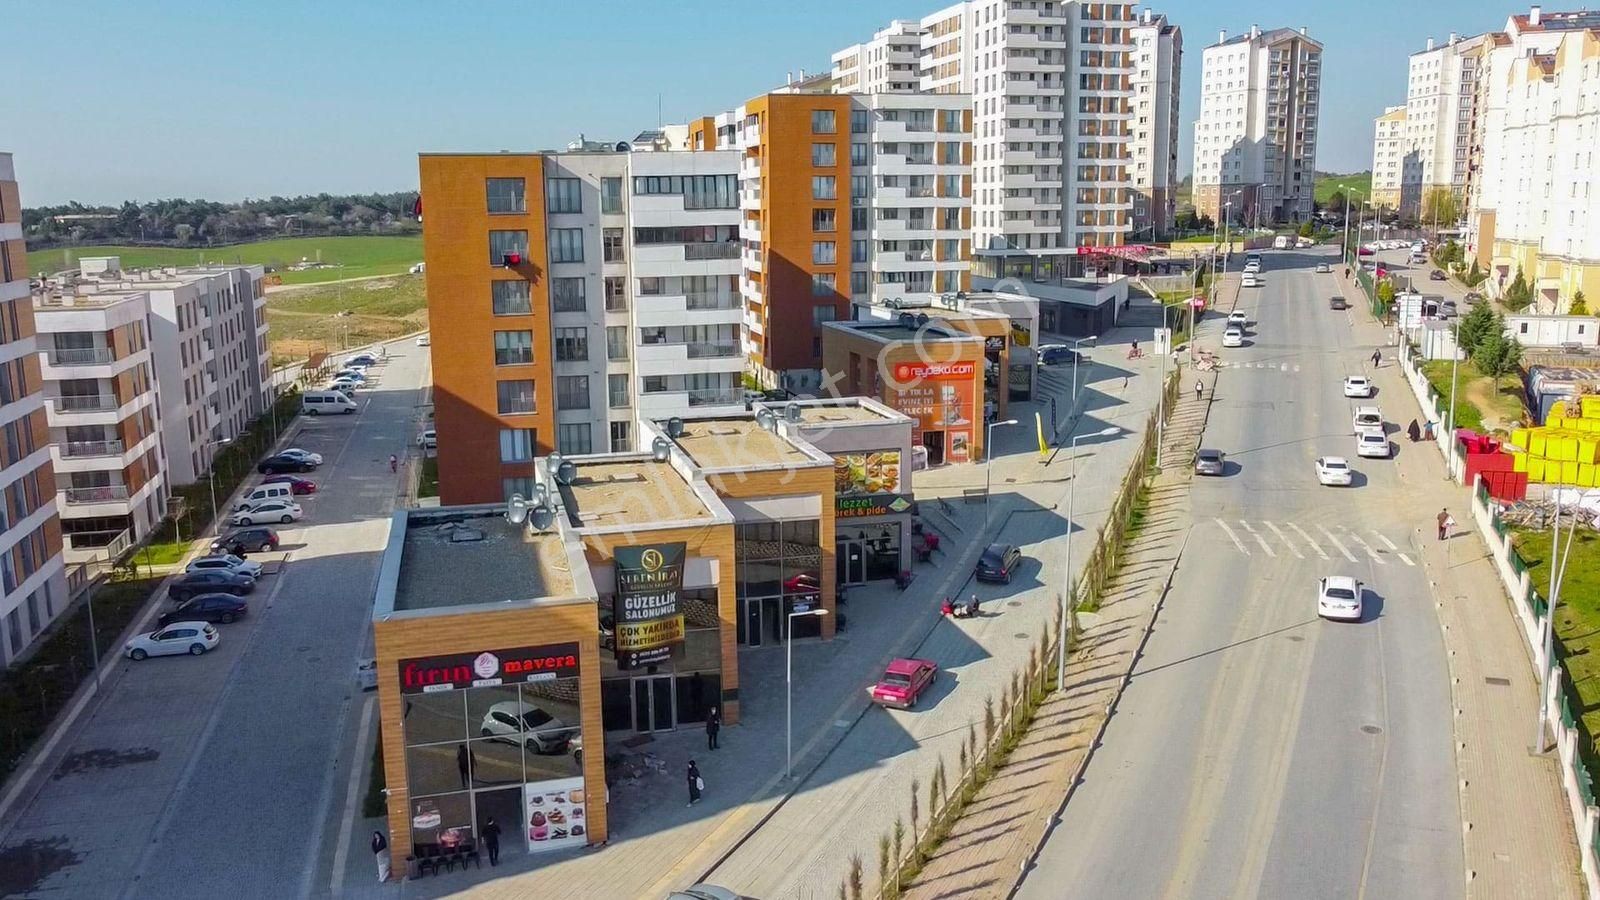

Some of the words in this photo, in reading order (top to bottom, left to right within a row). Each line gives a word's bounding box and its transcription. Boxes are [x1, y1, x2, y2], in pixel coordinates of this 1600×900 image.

[910, 363, 974, 378] reydeko.com
[839, 497, 874, 509] lezzet
[857, 507, 865, 516] &
[866, 505, 887, 516] pide
[625, 590, 677, 610] GÜZELLİK
[624, 603, 677, 620] SALONUMUZ
[620, 626, 641, 638] ÇOK
[642, 618, 680, 635] YAKINDA
[503, 654, 577, 673] mavera
